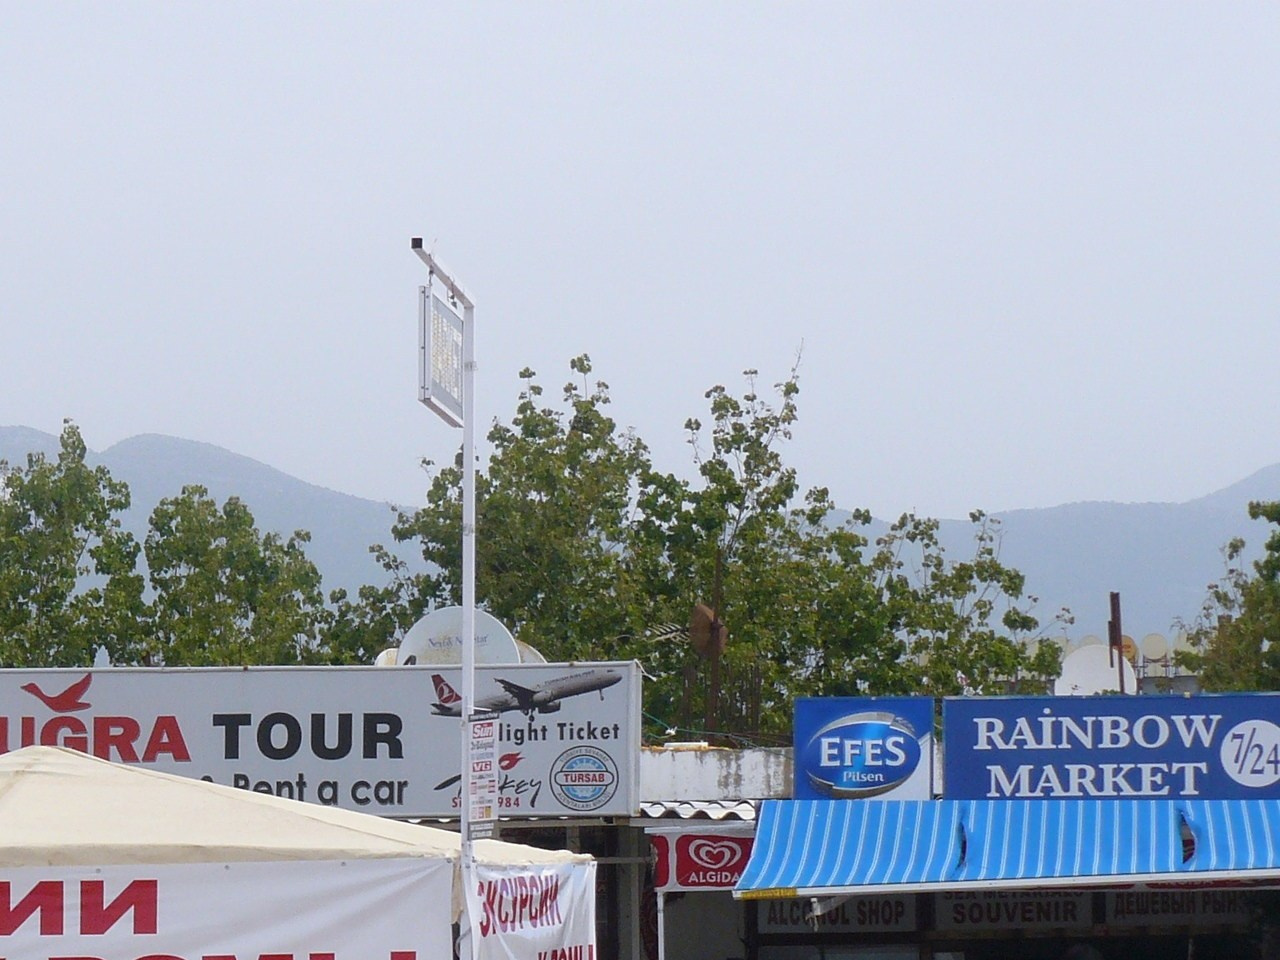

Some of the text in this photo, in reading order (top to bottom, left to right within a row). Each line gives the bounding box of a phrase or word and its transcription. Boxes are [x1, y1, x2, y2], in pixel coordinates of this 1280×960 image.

[213, 712, 404, 760] TOUR
[498, 721, 548, 746] light
[557, 720, 620, 741] Ticket
[820, 736, 906, 767] EFES
[1230, 727, 1280, 775] 7/24
[473, 762, 490, 771] VG
[563, 773, 605, 783] TURSAB
[843, 771, 885, 784] Pilsen
[986, 762, 1208, 797] MARKET
[233, 773, 408, 806] Rent a car
[498, 796, 520, 808] 984
[857, 899, 905, 925] SHOP
[952, 901, 1077, 923] SOUVENIR
